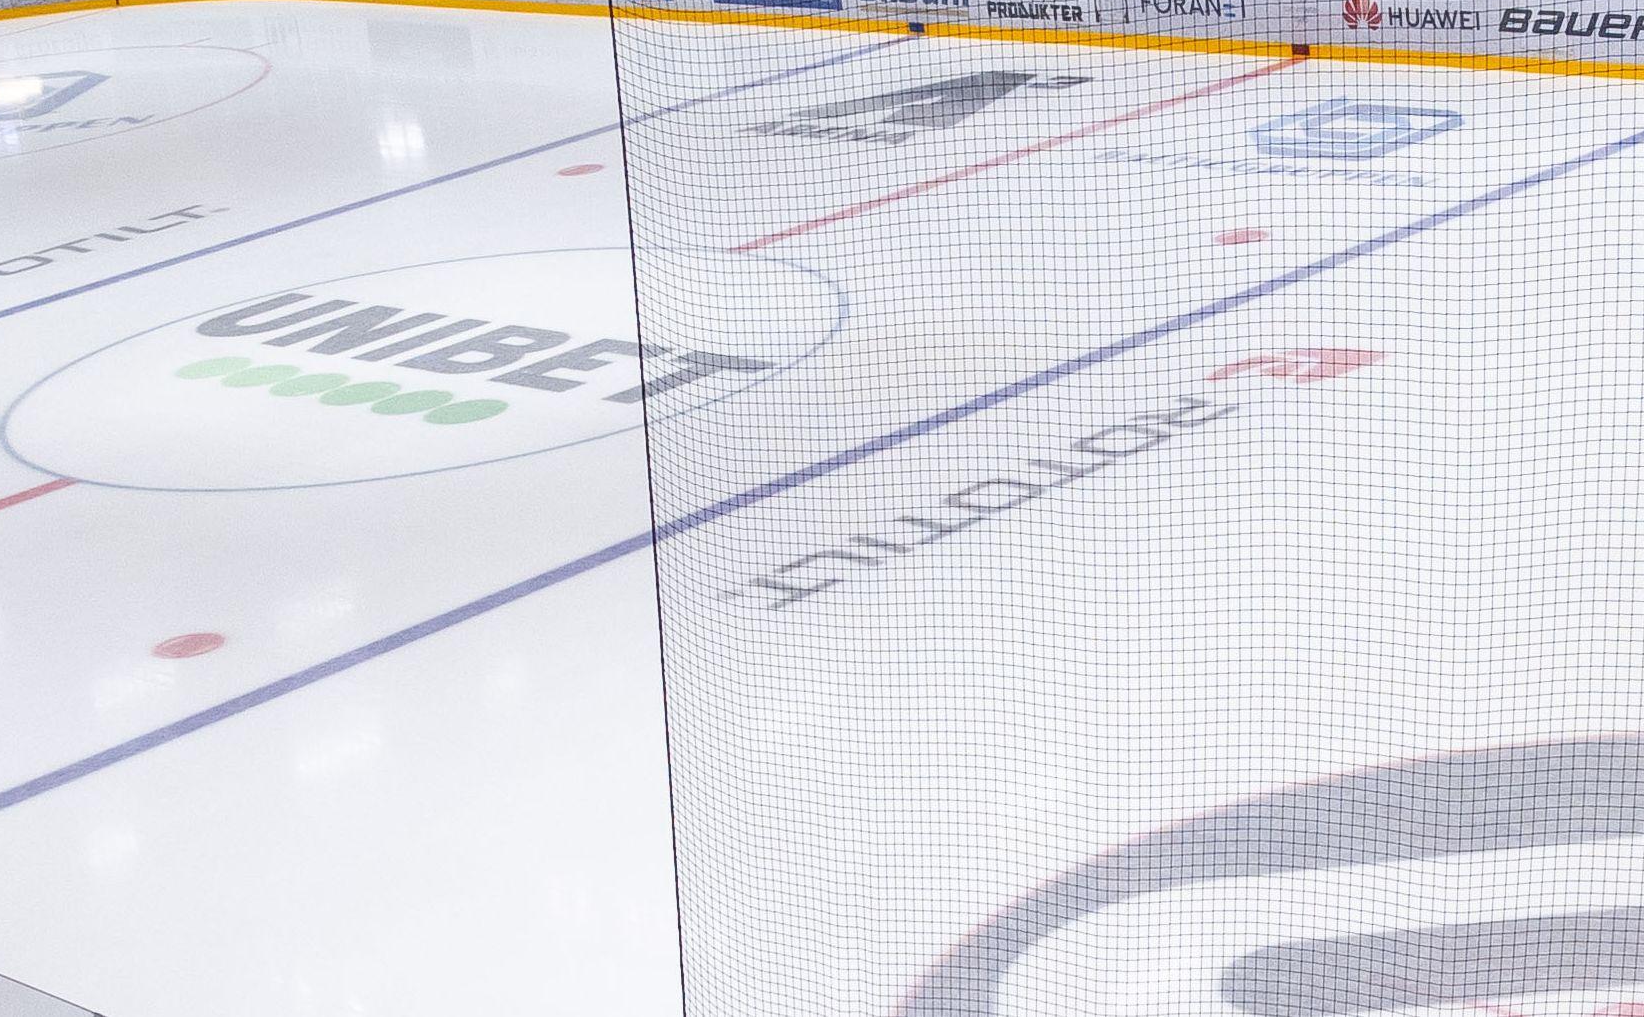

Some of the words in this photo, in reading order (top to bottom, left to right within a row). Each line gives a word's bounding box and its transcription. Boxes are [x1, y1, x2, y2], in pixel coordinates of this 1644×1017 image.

[987, 1, 1083, 23] PRODUKTER
[1388, 5, 1482, 33] HUAWEI
[195, 292, 777, 405] UNIBET
